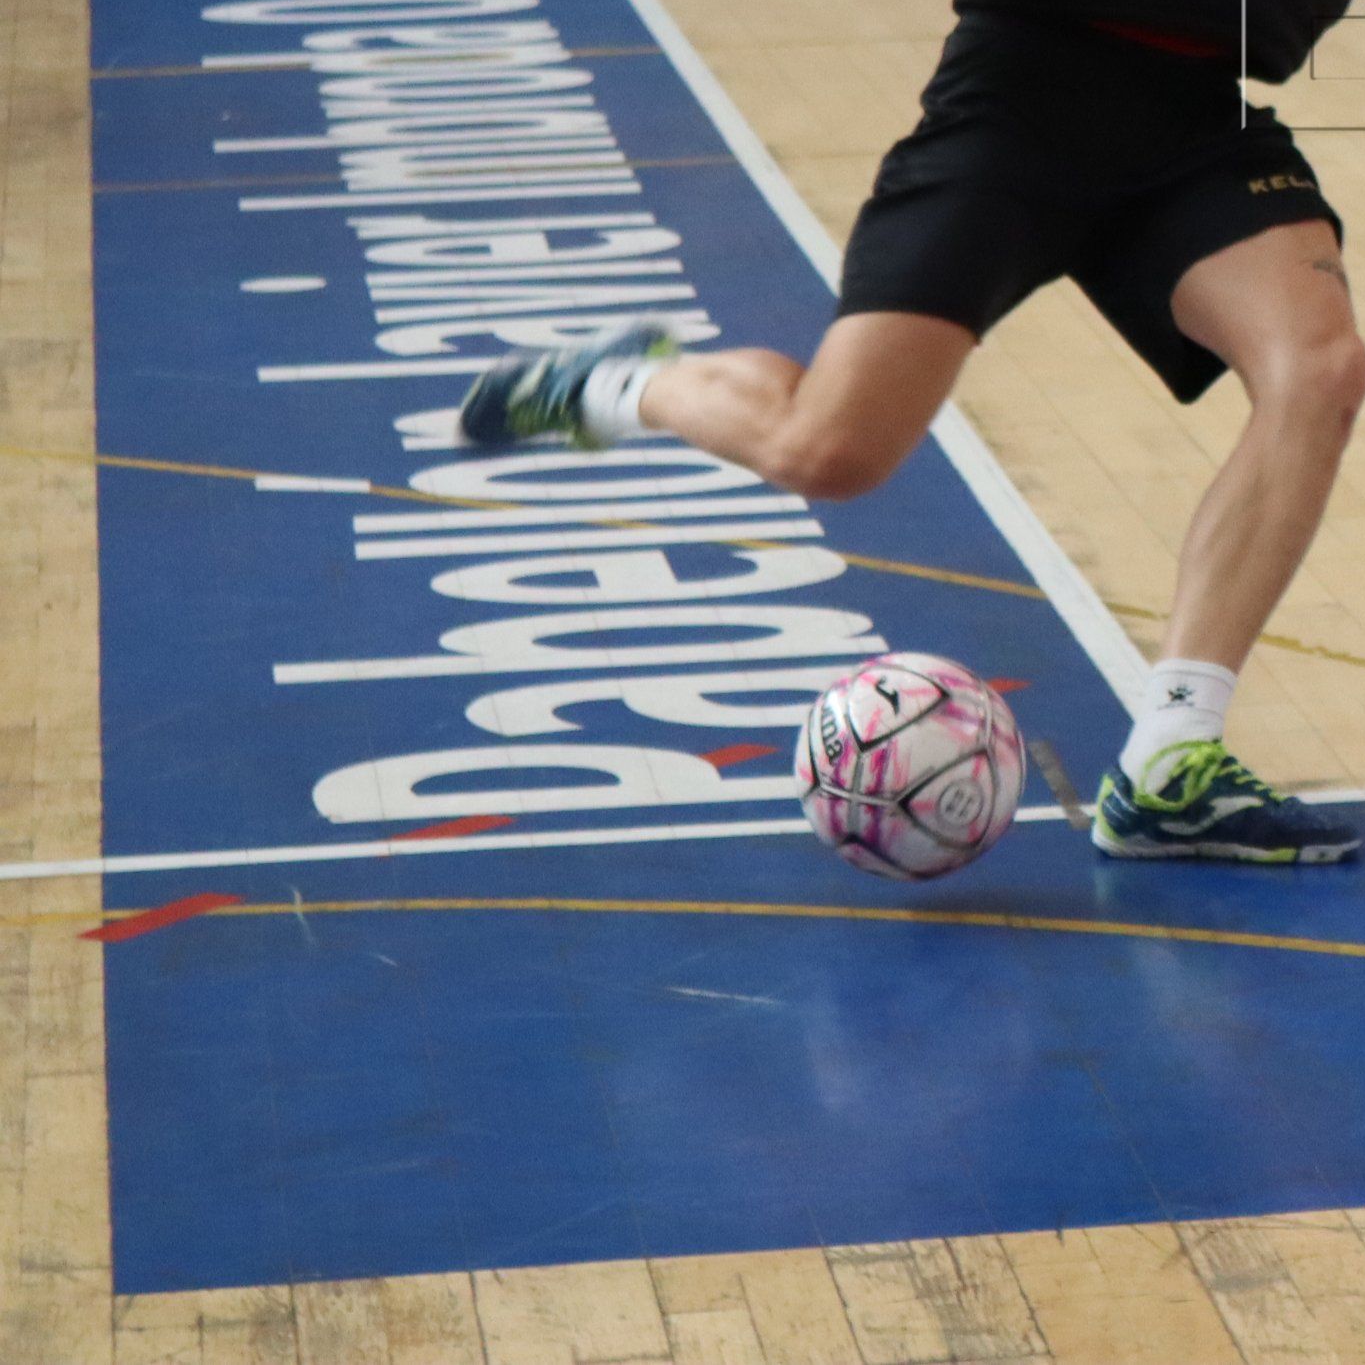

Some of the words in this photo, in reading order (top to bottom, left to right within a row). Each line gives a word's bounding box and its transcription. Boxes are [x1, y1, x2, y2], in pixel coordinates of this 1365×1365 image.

[202, 20, 642, 211] Imbroda
[1248, 173, 1317, 195] KEL
[240, 214, 721, 382] Javier
[255, 408, 890, 824] Pabelló
